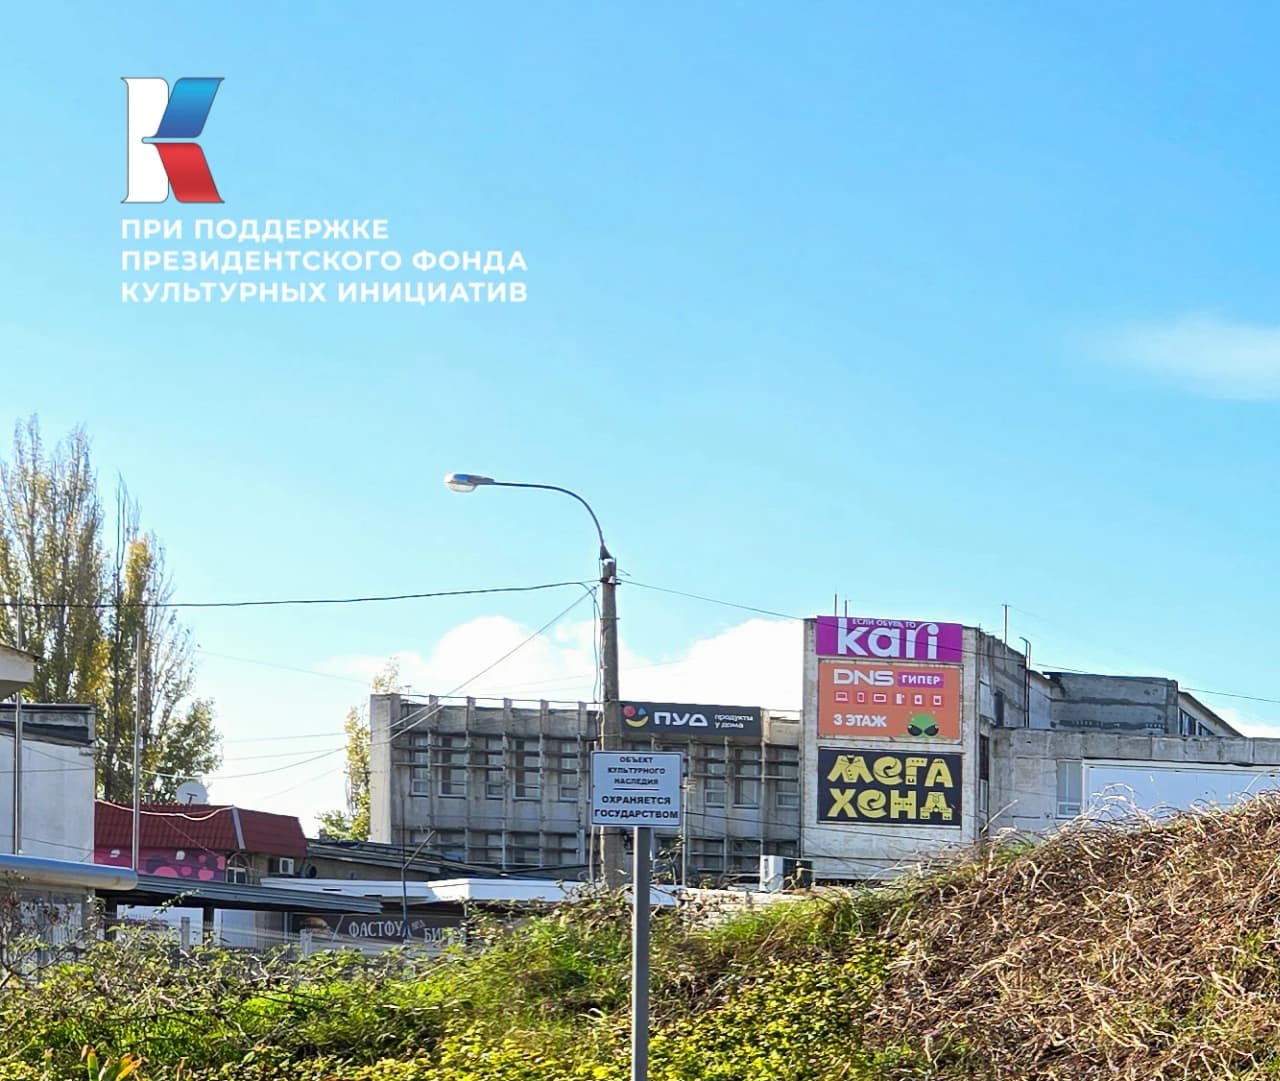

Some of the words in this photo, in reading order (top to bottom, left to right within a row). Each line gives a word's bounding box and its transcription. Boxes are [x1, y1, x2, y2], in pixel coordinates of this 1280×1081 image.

[852, 618, 875, 626] ЕСЛИ
[905, 621, 917, 629] ТО
[837, 617, 940, 660] kari
[833, 668, 894, 687] DNS
[901, 675, 941, 685] ГИПЕР
[714, 713, 753, 722] продукты
[833, 713, 843, 726] 3
[845, 714, 887, 728] ЭТАЖ
[608, 767, 666, 775] КУЛЬТУРНОГО
[602, 796, 671, 805] ОХРАНЯЕТСЯ
[594, 809, 678, 819] ГОСУДАРСТВОМ
